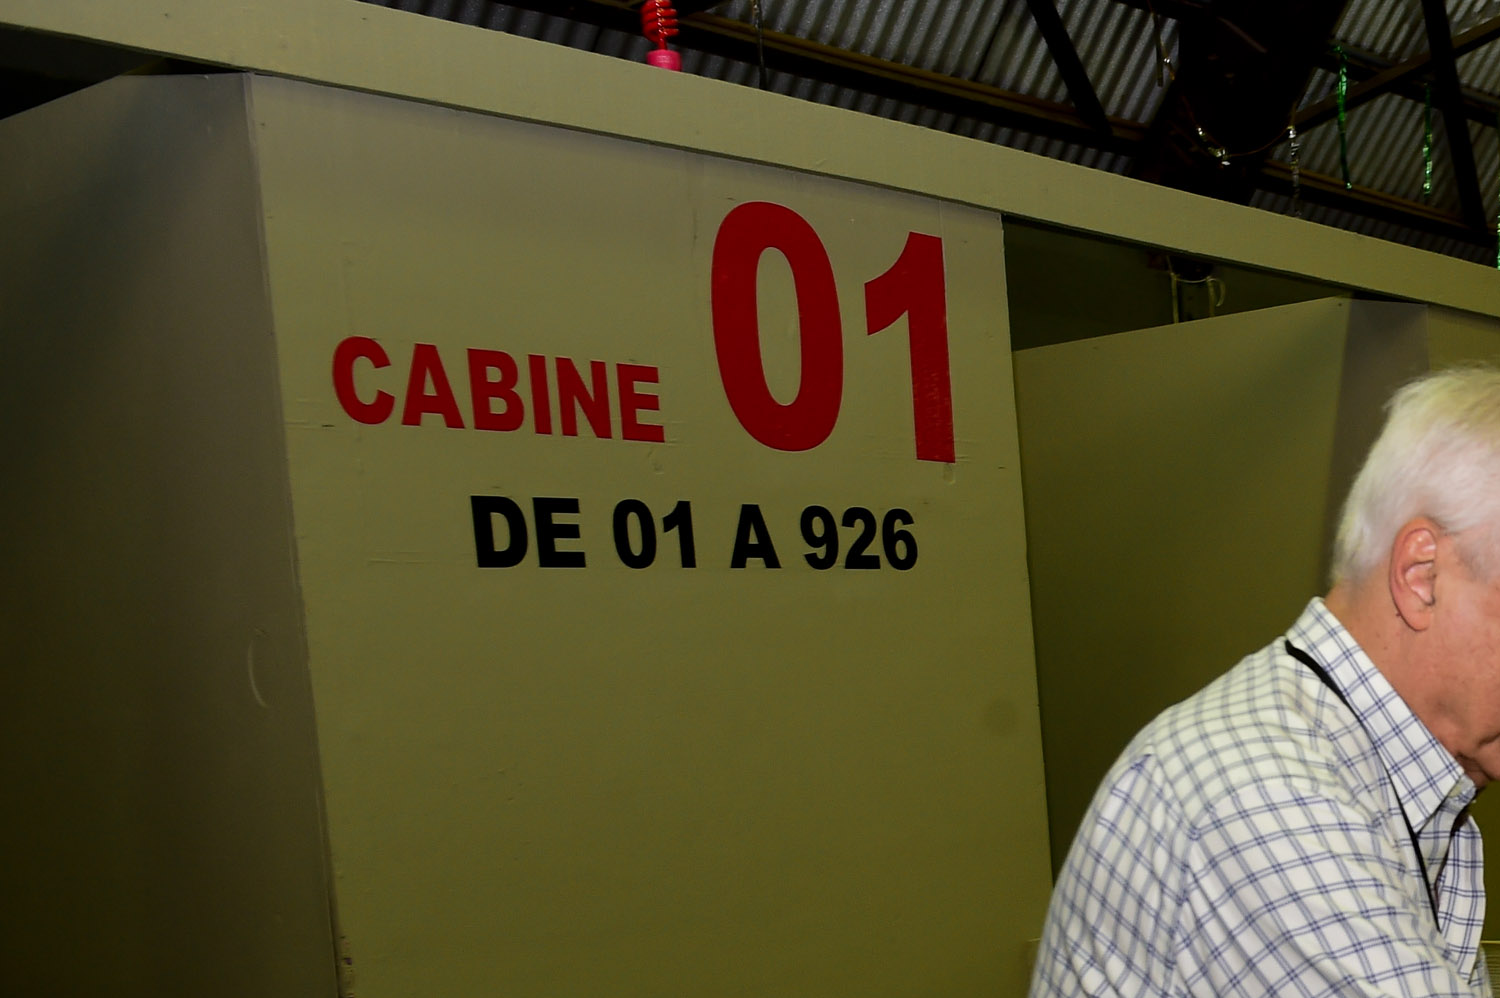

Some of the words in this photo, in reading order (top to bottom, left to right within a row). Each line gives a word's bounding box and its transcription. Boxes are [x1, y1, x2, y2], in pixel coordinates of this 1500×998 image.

[332, 335, 666, 443] CABINE
[710, 200, 957, 464] 01
[470, 494, 587, 568] DE
[612, 498, 697, 569] 01
[729, 503, 782, 569] A
[800, 505, 919, 571] 926
